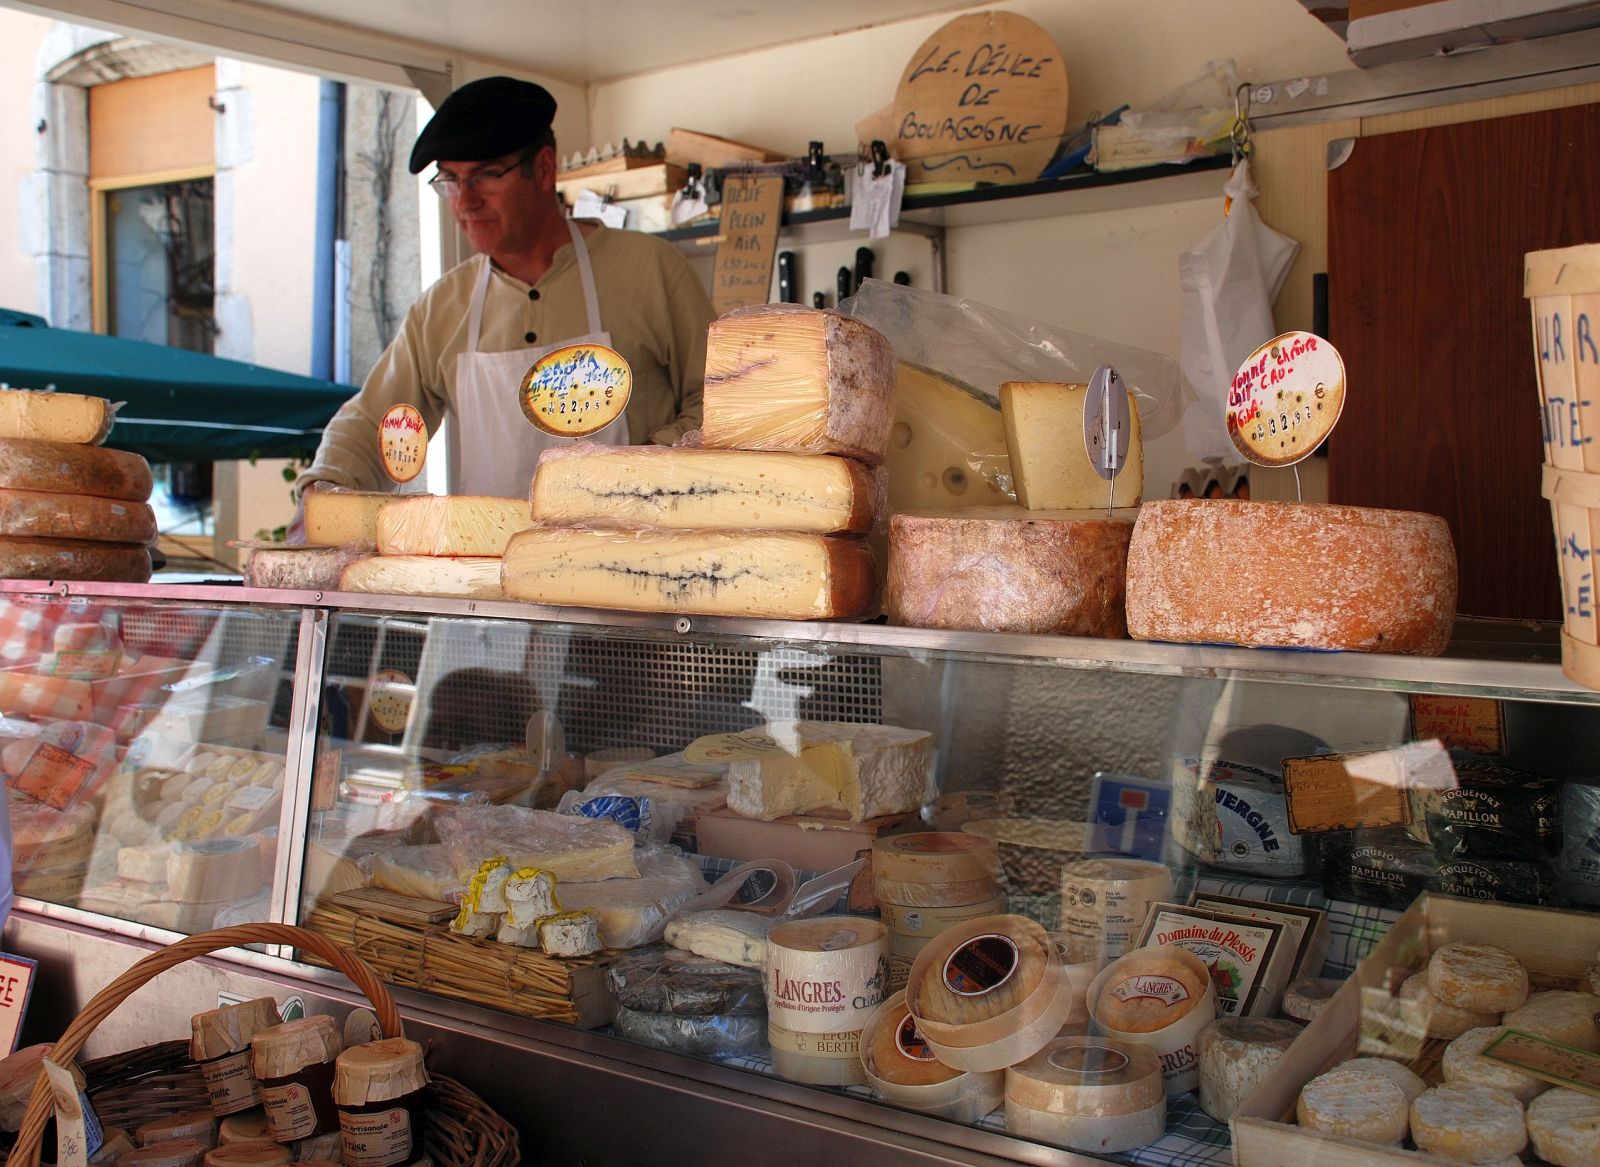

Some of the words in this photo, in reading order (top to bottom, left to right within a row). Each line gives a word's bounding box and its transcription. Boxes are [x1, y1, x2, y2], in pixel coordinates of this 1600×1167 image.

[958, 83, 1000, 108] DE
[898, 111, 1042, 144] BOURGOGNE
[729, 210, 765, 229] PLEIN
[1351, 865, 1404, 882] PAPILLON
[1156, 925, 1208, 945] Domaine
[1209, 927, 1224, 941] du
[1220, 930, 1257, 963] Plessis
[350, 1122, 389, 1133] Artisanale
